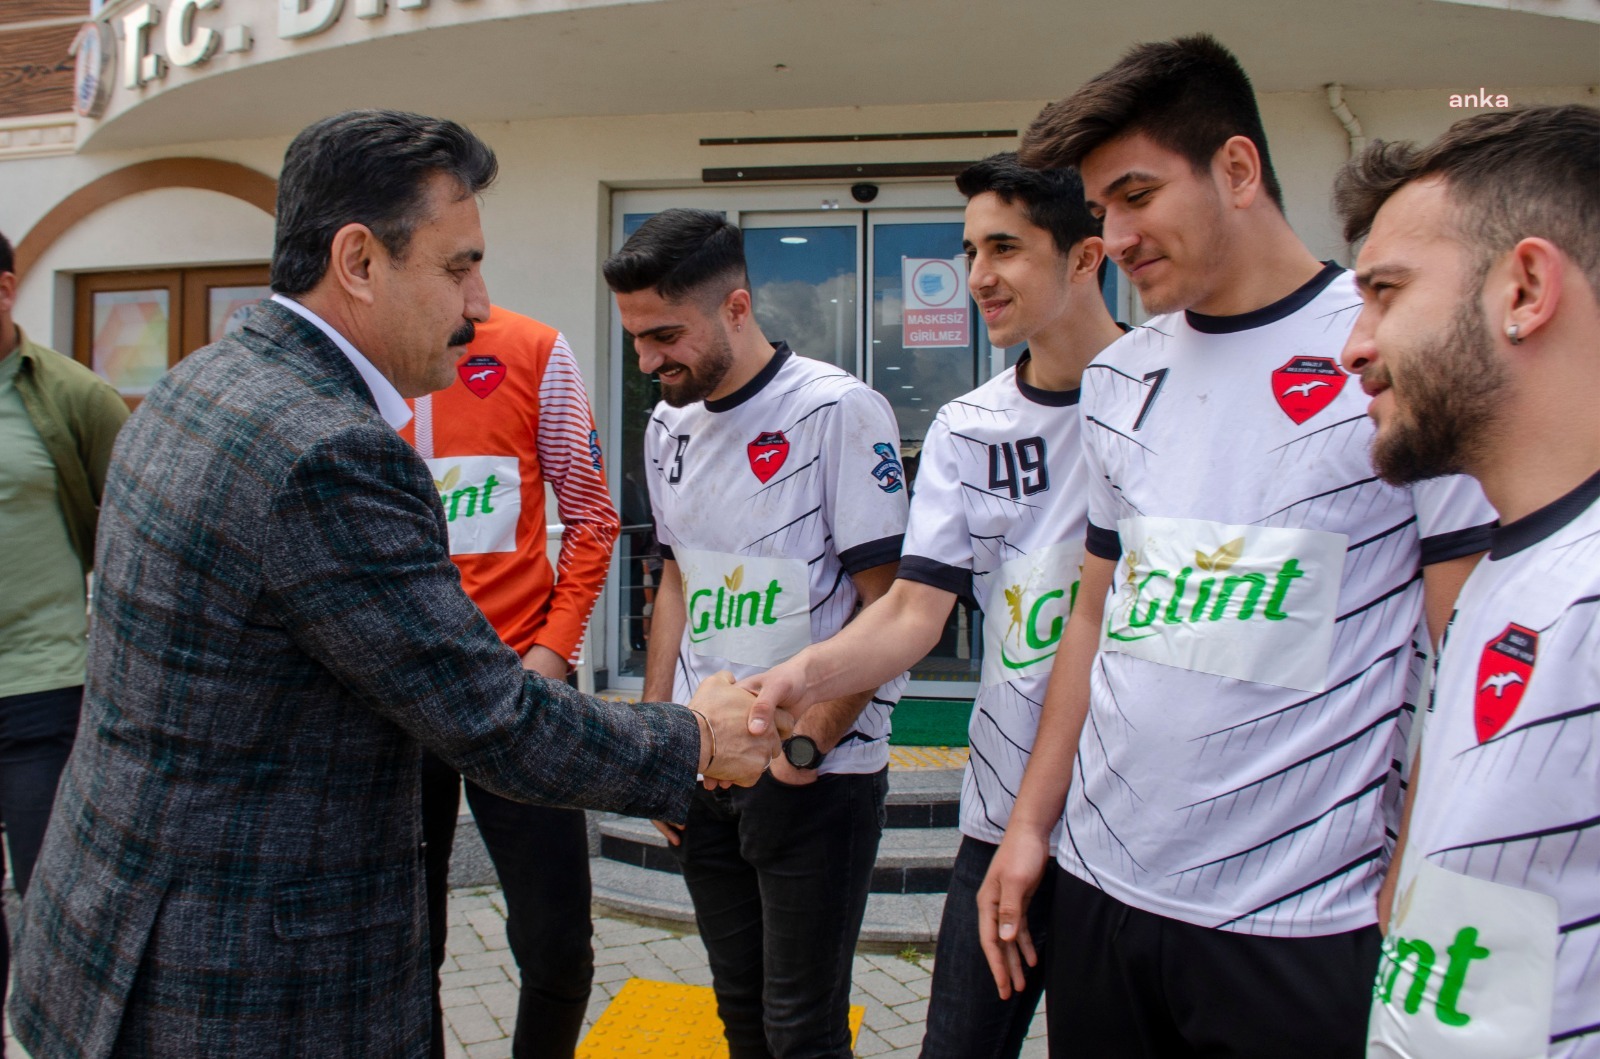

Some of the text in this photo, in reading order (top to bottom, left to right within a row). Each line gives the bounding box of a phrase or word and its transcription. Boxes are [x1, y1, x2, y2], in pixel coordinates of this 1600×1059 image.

[907, 312, 964, 325] MASKESİZ
[909, 330, 962, 342] GİRİLMEZ
[1132, 367, 1170, 432] 7
[988, 435, 1050, 500] 49
[689, 579, 782, 634] Glint
[1128, 558, 1305, 628] Glint
